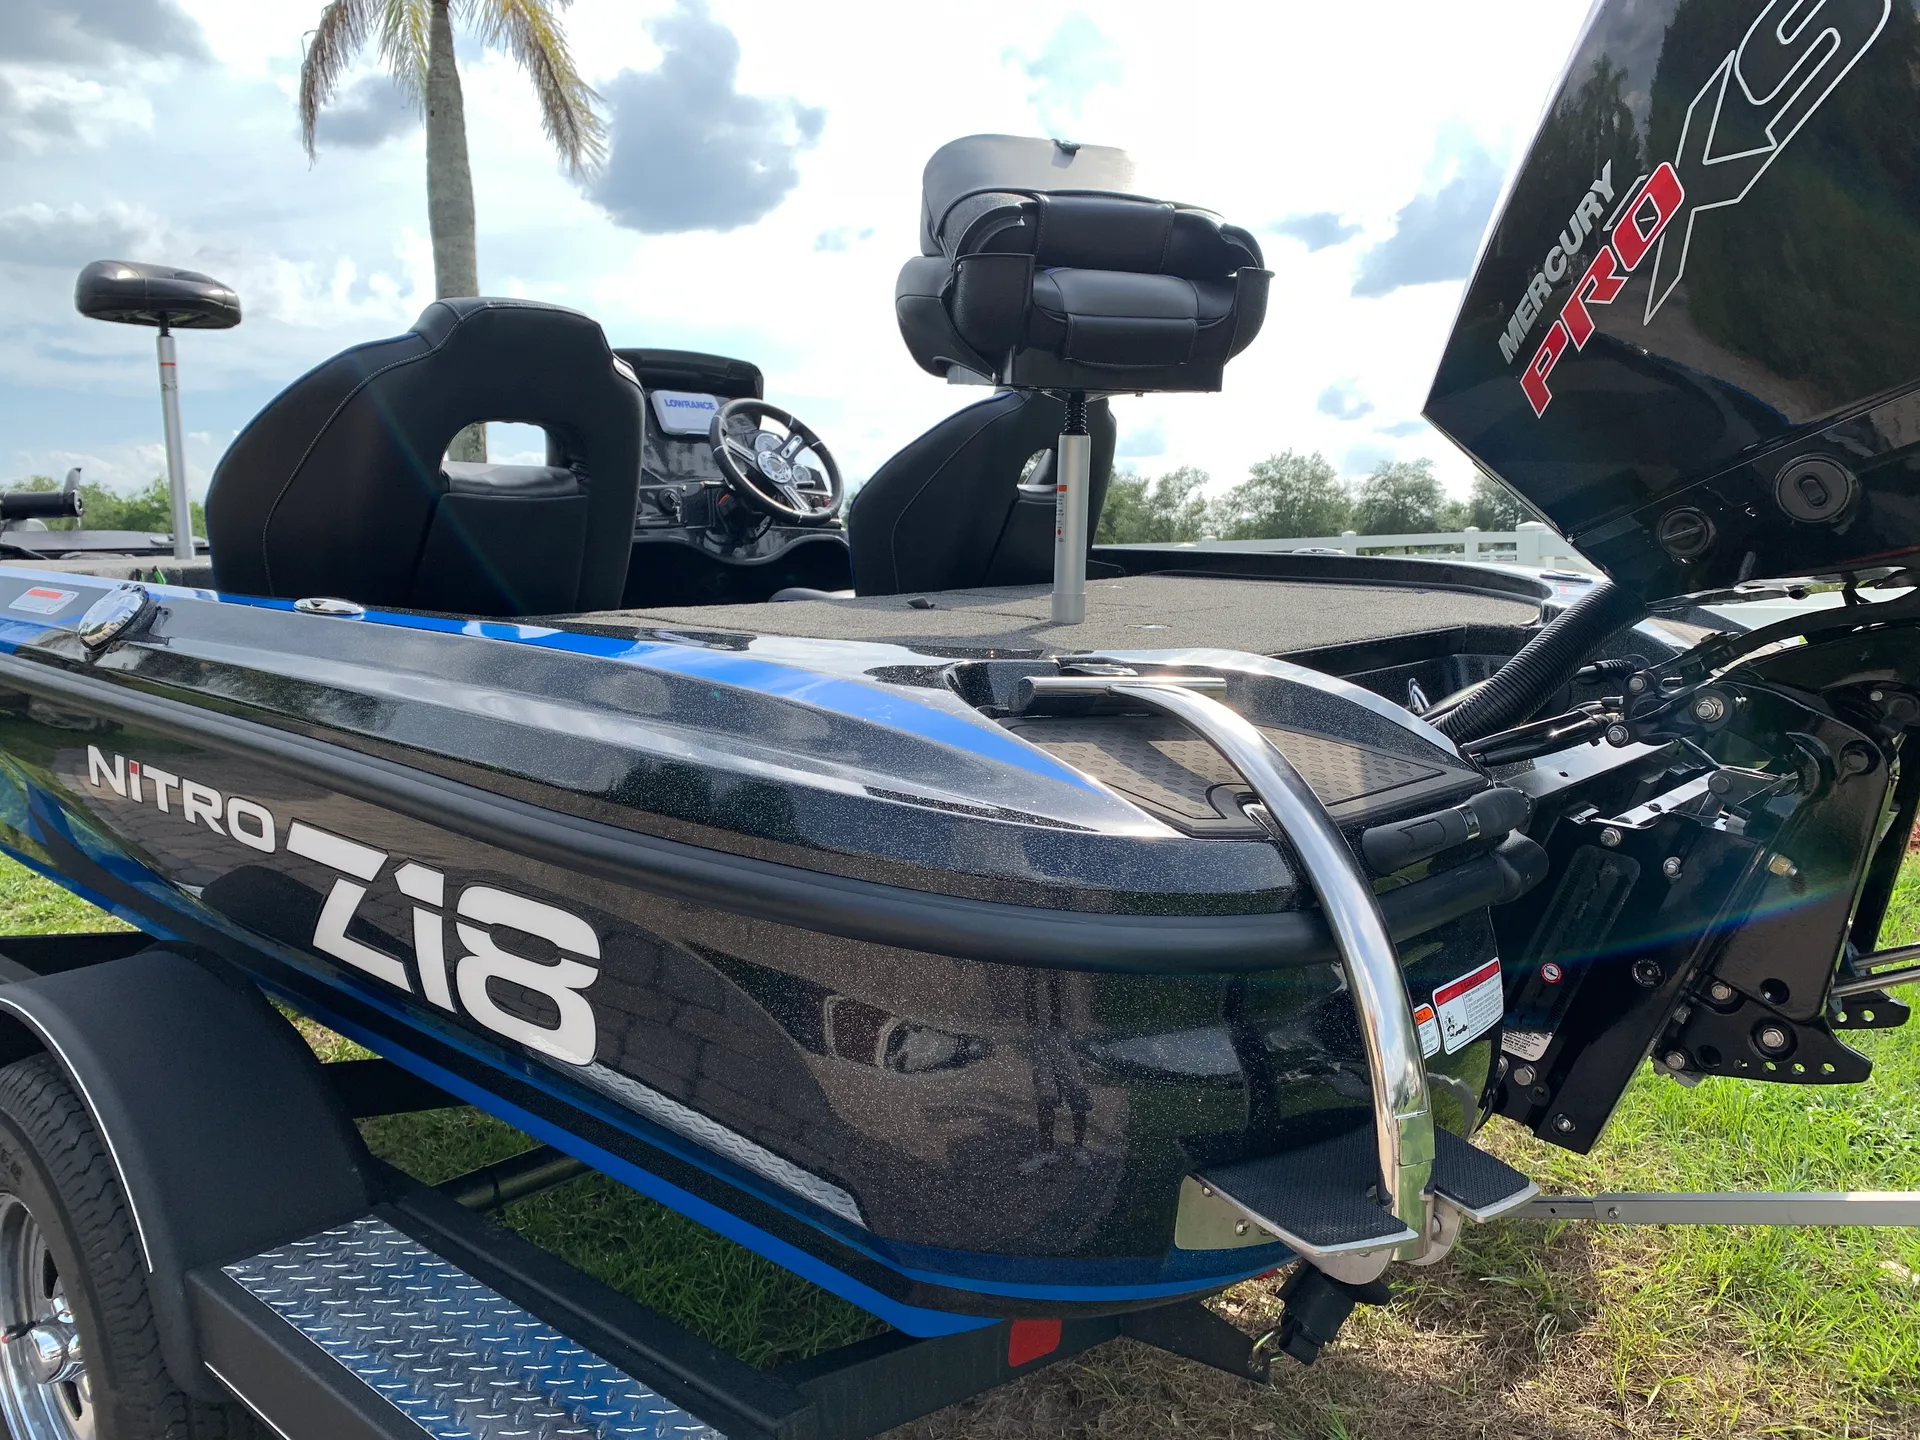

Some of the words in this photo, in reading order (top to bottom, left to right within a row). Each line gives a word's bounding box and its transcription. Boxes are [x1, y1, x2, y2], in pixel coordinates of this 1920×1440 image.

[1498, 158, 1614, 365] MERCURY
[1519, 161, 1686, 420] PRO
[663, 398, 716, 411] LOWRANCE
[87, 744, 276, 854] NITRO
[285, 820, 601, 1066] Z18
